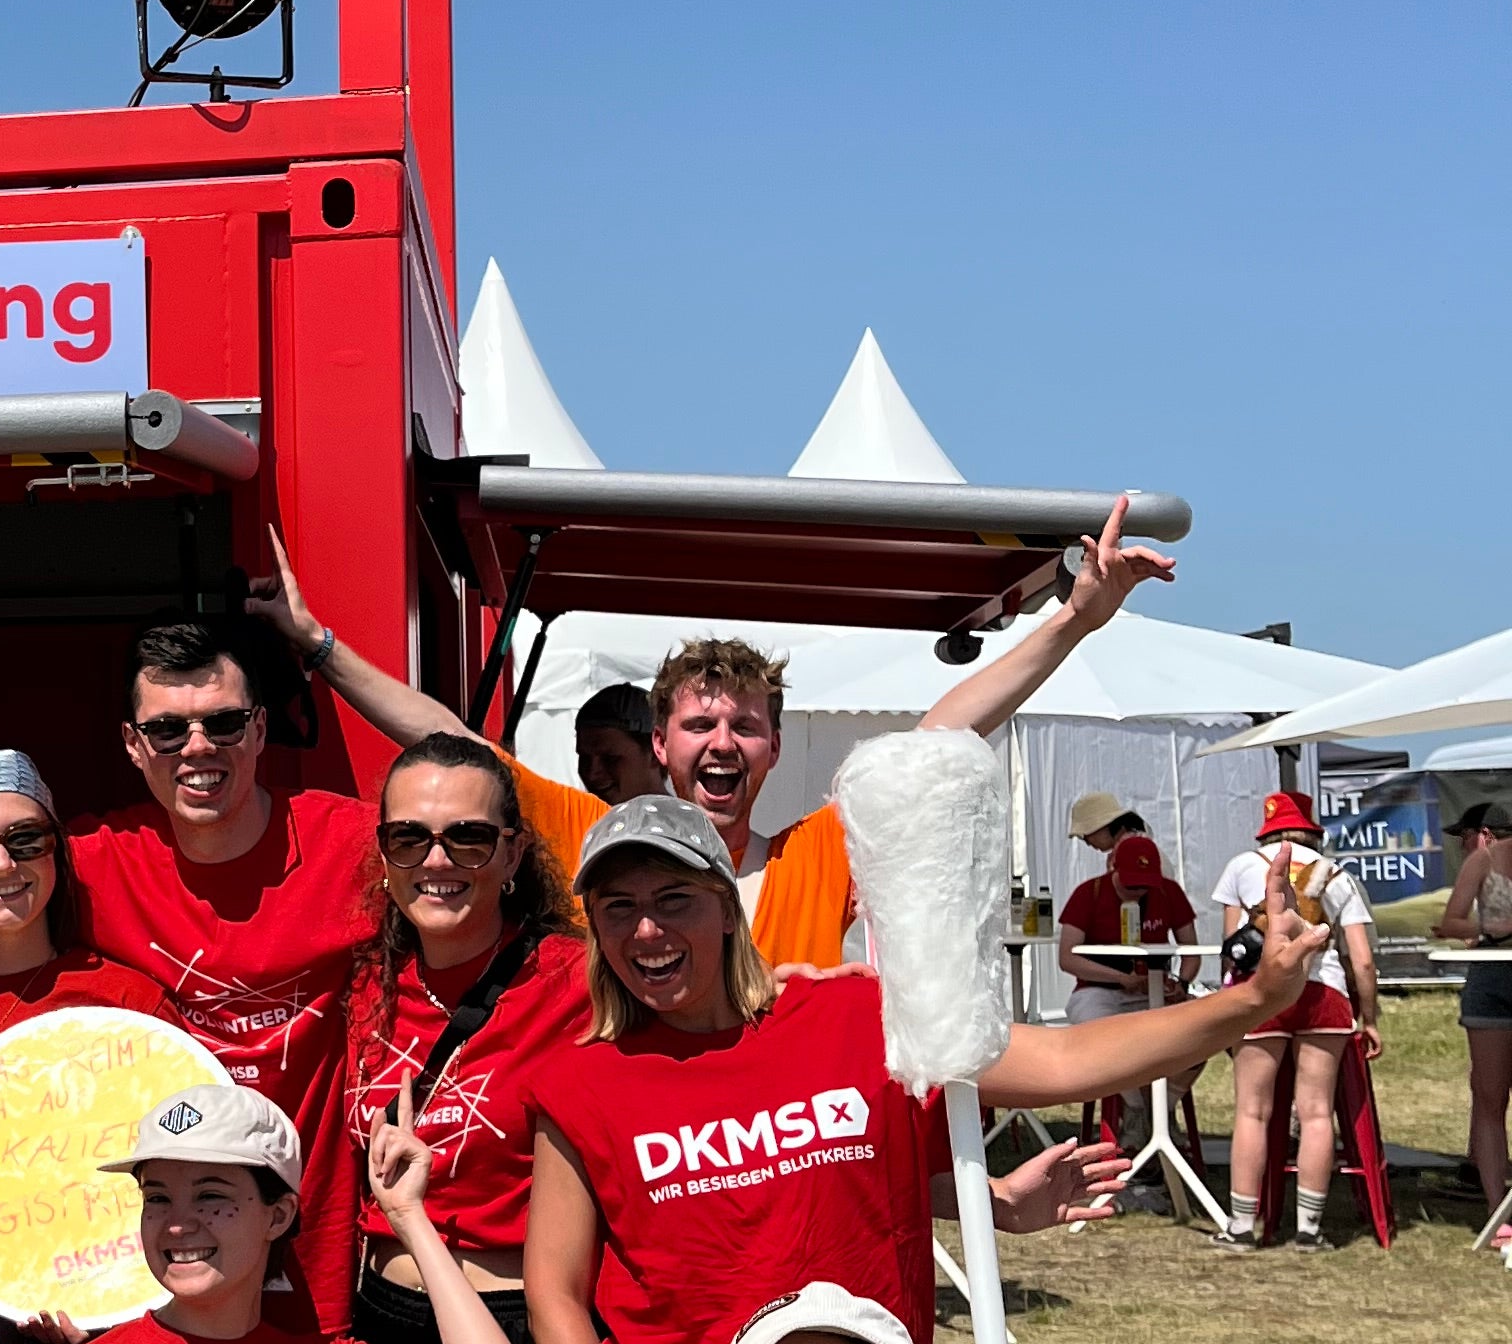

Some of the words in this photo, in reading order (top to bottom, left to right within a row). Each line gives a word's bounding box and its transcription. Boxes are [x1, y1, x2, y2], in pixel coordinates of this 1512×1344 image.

[1320, 792, 1363, 816] IFT
[1338, 821, 1388, 848] MIT
[1335, 854, 1425, 881] CHEN
[65, 1029, 162, 1075] REIMT
[633, 1101, 816, 1183] DKMS
[648, 1183, 683, 1204] WIR
[687, 1165, 774, 1196] BESIEGEN
[778, 1144, 875, 1176] BLUTKREBS
[53, 1234, 137, 1278] DKMS
